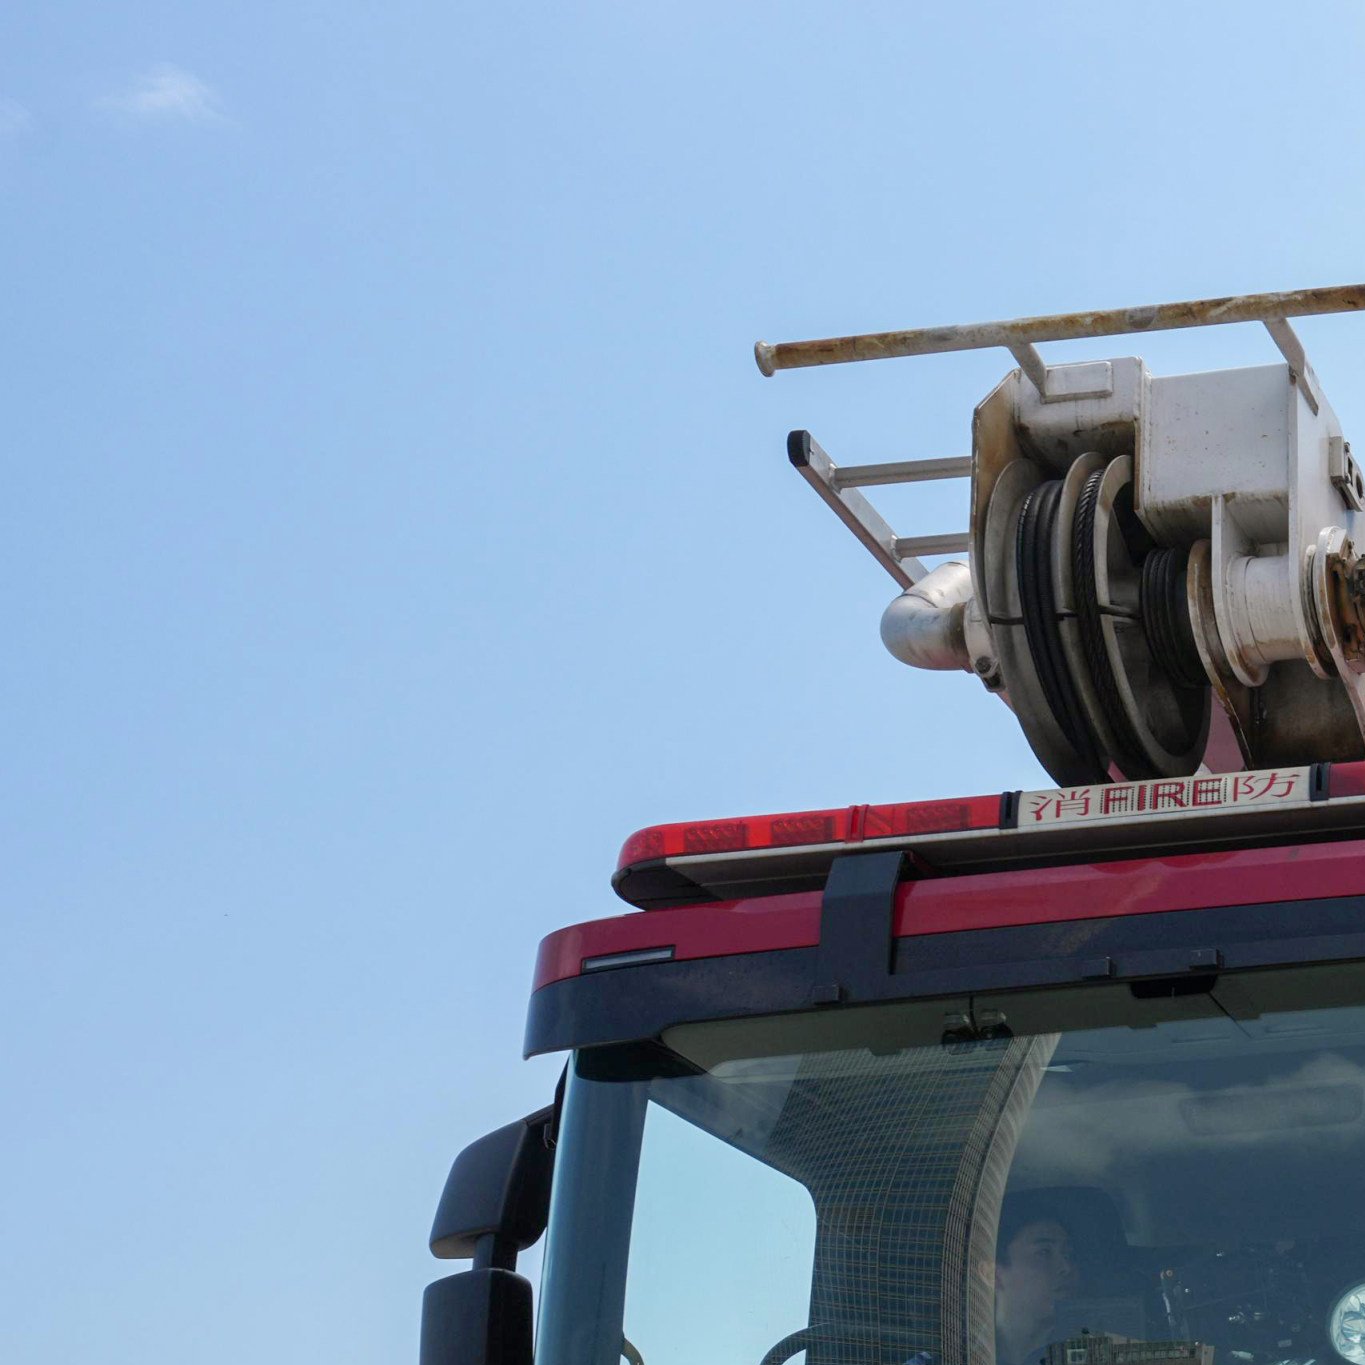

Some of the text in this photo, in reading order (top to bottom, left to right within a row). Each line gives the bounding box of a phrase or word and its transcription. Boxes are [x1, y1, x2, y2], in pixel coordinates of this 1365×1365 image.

[1030, 772, 1302, 821] 消 FIRE 防
